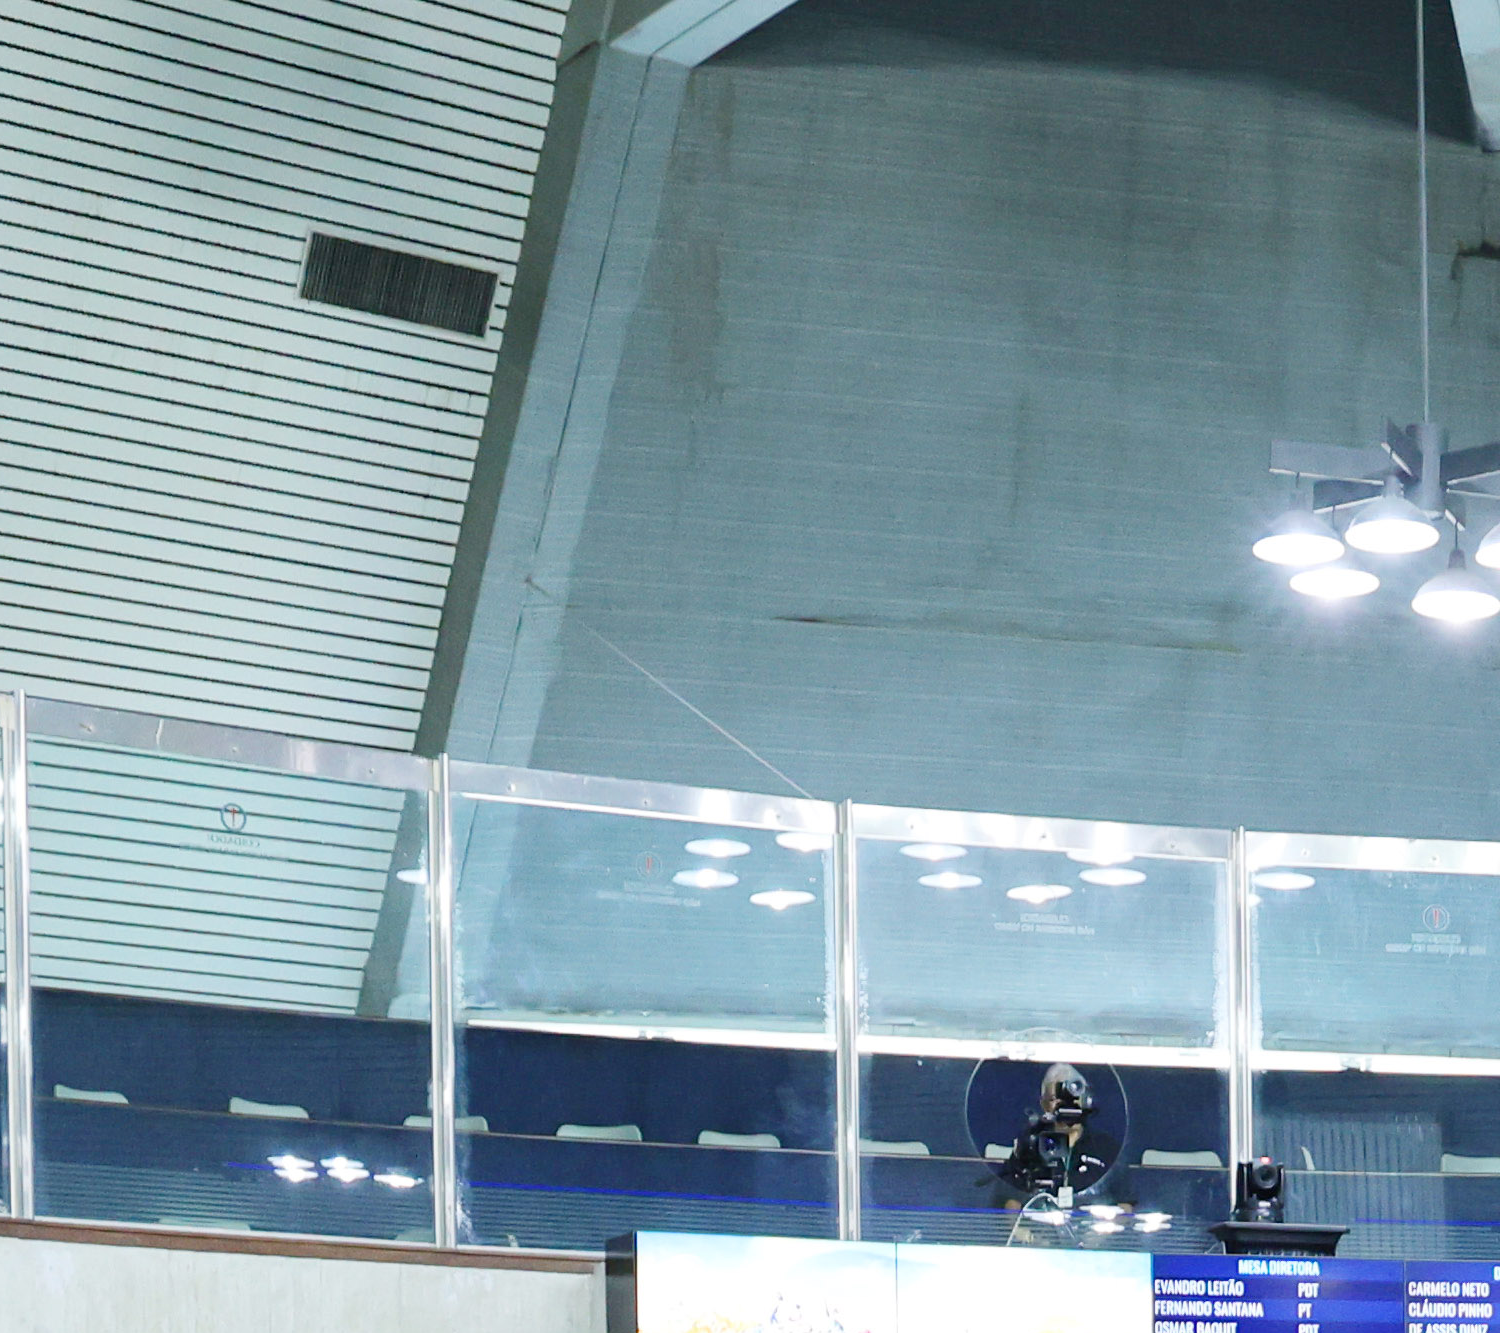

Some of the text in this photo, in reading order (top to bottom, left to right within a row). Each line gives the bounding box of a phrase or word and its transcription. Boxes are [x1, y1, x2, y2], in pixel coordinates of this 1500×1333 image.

[1238, 1260, 1320, 1276] MESA DIRETORA
[1155, 1280, 1244, 1296] EVANDRO LEITÃO
[1298, 1283, 1319, 1298] PDT
[1408, 1282, 1489, 1297] CARMELO NETO
[1155, 1302, 1264, 1317] FERNANDO SANTANA
[1298, 1303, 1312, 1318] PT
[1408, 1299, 1492, 1318] CLÁUDIO PINHO
